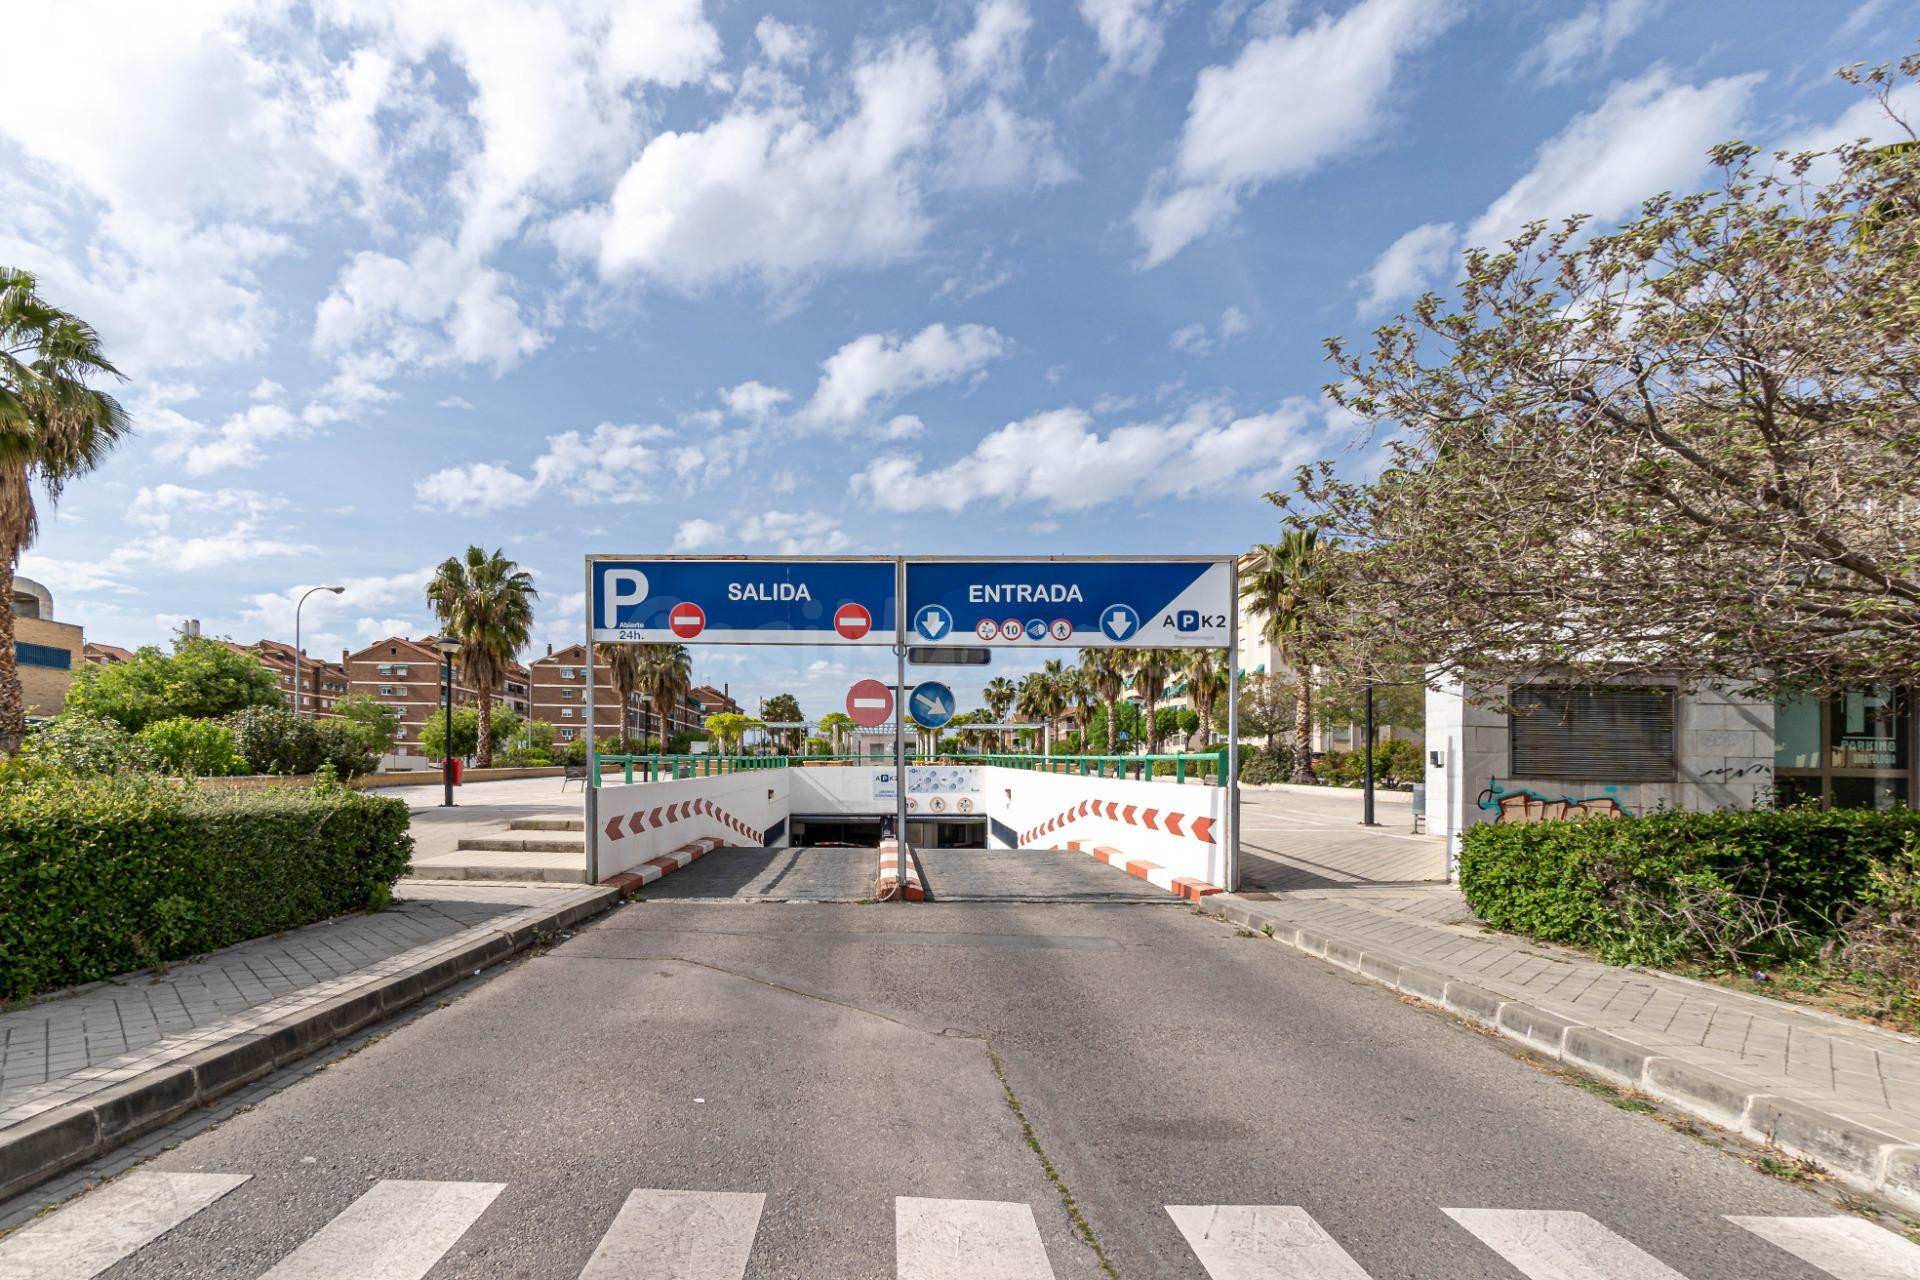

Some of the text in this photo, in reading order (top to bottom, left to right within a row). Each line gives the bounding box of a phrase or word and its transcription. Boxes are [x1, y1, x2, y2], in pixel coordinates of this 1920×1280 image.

[603, 568, 650, 629] P
[727, 583, 811, 601] SALIDA
[968, 584, 1084, 602] ENTRADA
[619, 621, 645, 629] Abierto
[1005, 624, 1019, 635] 10
[619, 629, 645, 640] 24h.
[1840, 739, 1897, 752] PARKING
